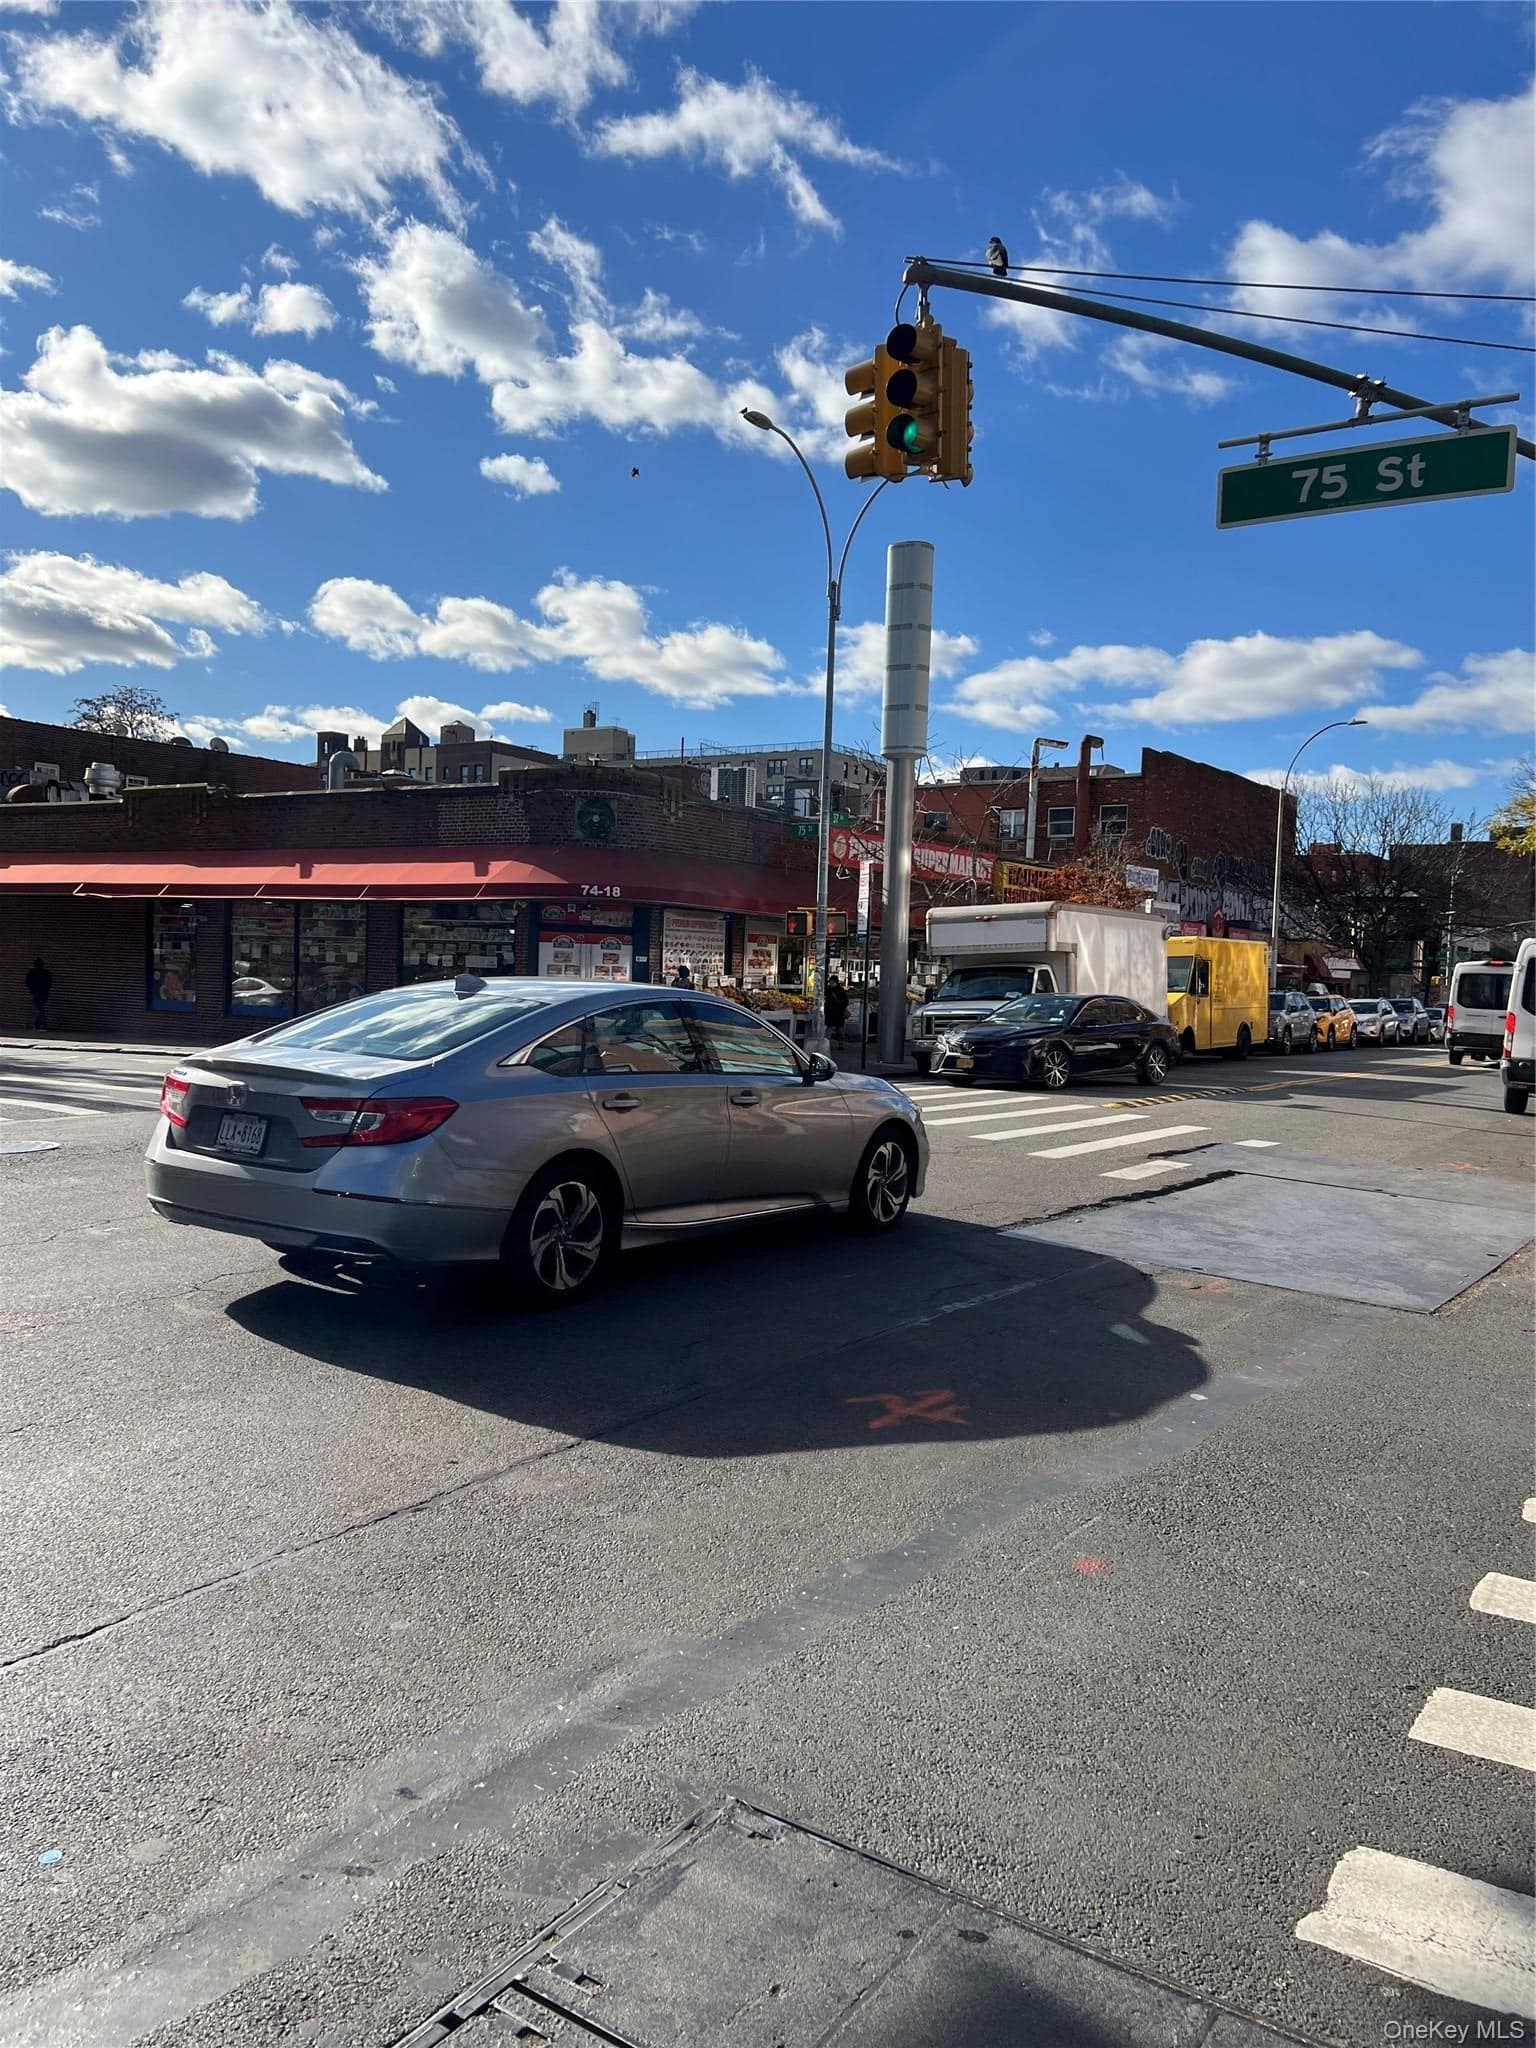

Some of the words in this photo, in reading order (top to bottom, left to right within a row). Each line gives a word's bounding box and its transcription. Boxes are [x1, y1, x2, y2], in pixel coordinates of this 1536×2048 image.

[1292, 463, 1347, 502] 75
[1375, 453, 1426, 492] St
[798, 825, 806, 836] 75
[580, 884, 621, 897] 74-18
